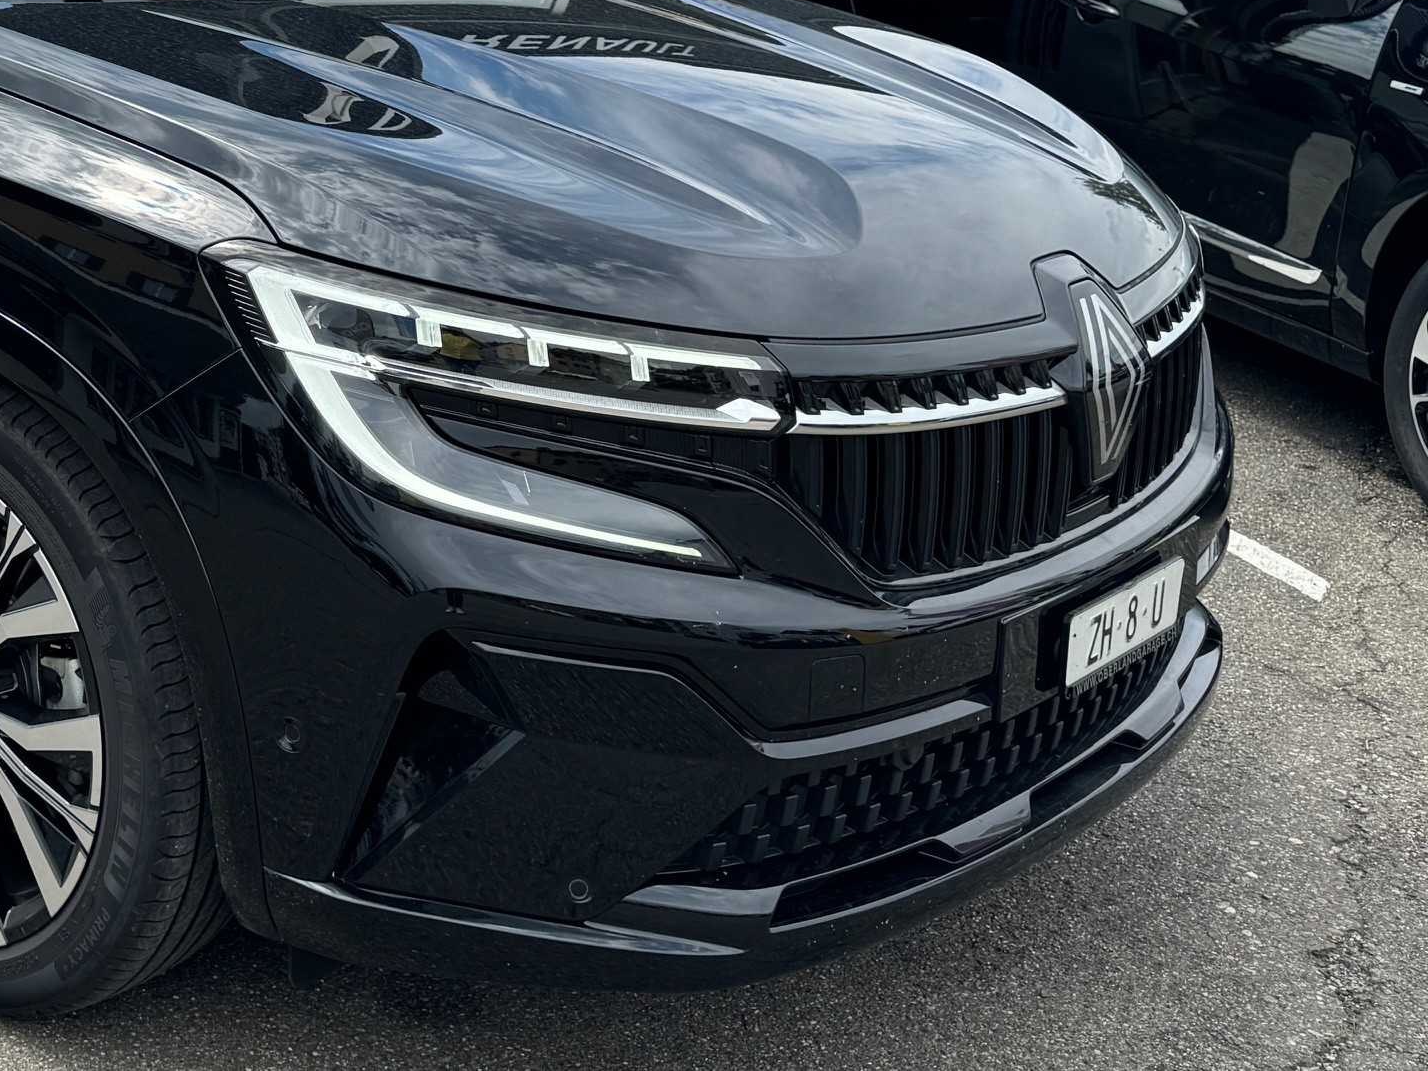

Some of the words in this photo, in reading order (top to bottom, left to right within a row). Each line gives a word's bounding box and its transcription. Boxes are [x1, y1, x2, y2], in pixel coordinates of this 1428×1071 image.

[1086, 605, 1114, 667] ZH
[1125, 595, 1139, 643] 8
[1151, 578, 1167, 628] U
